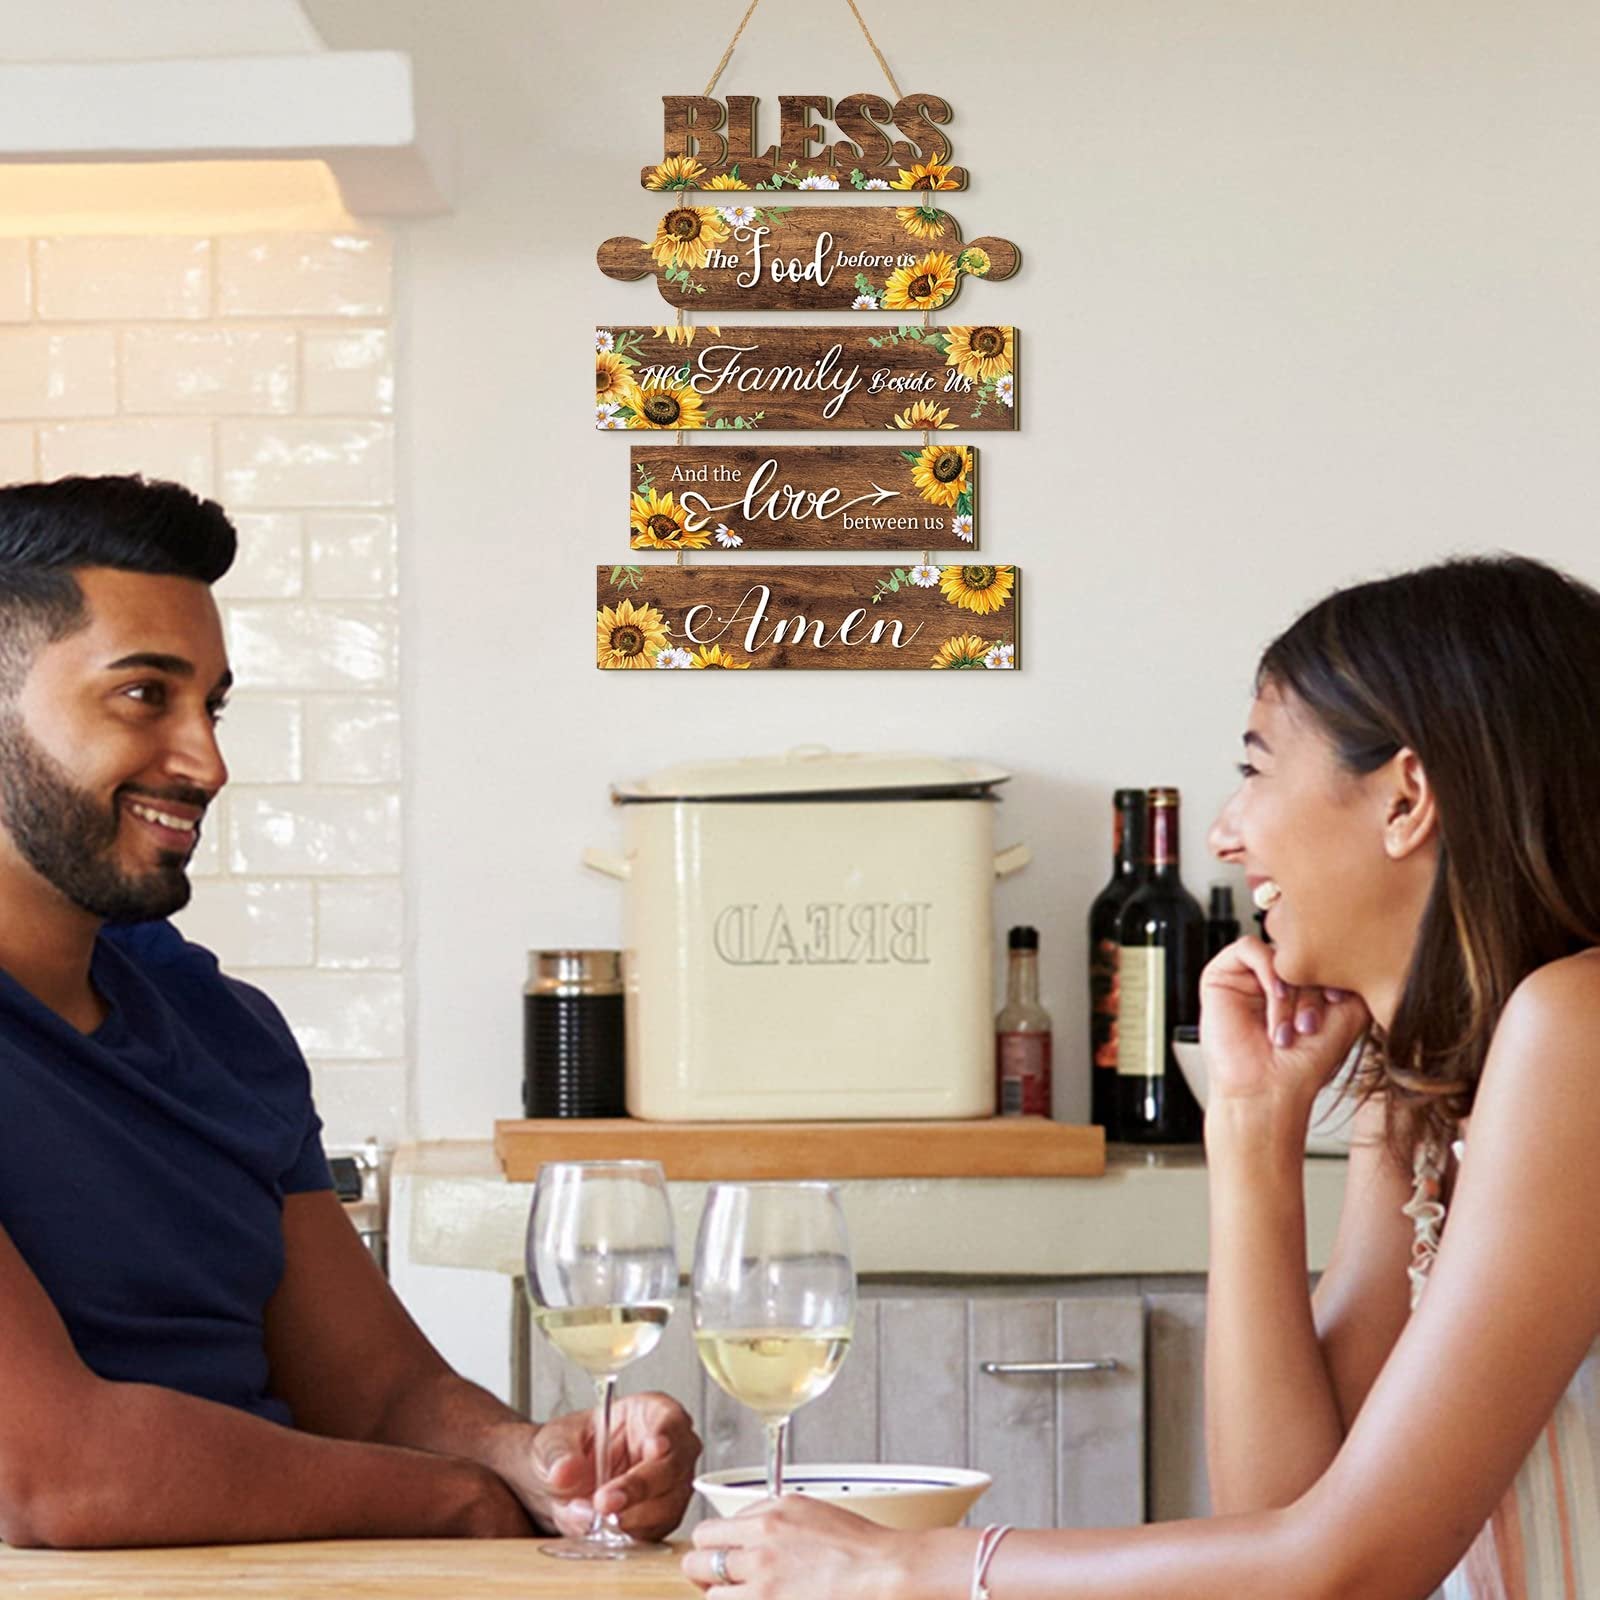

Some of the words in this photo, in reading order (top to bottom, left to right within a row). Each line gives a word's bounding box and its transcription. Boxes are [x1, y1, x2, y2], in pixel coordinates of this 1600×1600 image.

[662, 94, 953, 167] BLESS
[704, 248, 739, 270] The
[733, 226, 833, 288] Food
[836, 251, 893, 269] before
[896, 252, 916, 268] us
[690, 344, 862, 419] Family
[867, 368, 937, 394] Beside
[944, 368, 974, 394] Us
[671, 465, 708, 482] And
[713, 465, 741, 482] the
[742, 459, 842, 521] love
[843, 512, 920, 531] between
[924, 517, 945, 531] us
[664, 585, 925, 653] Amen
